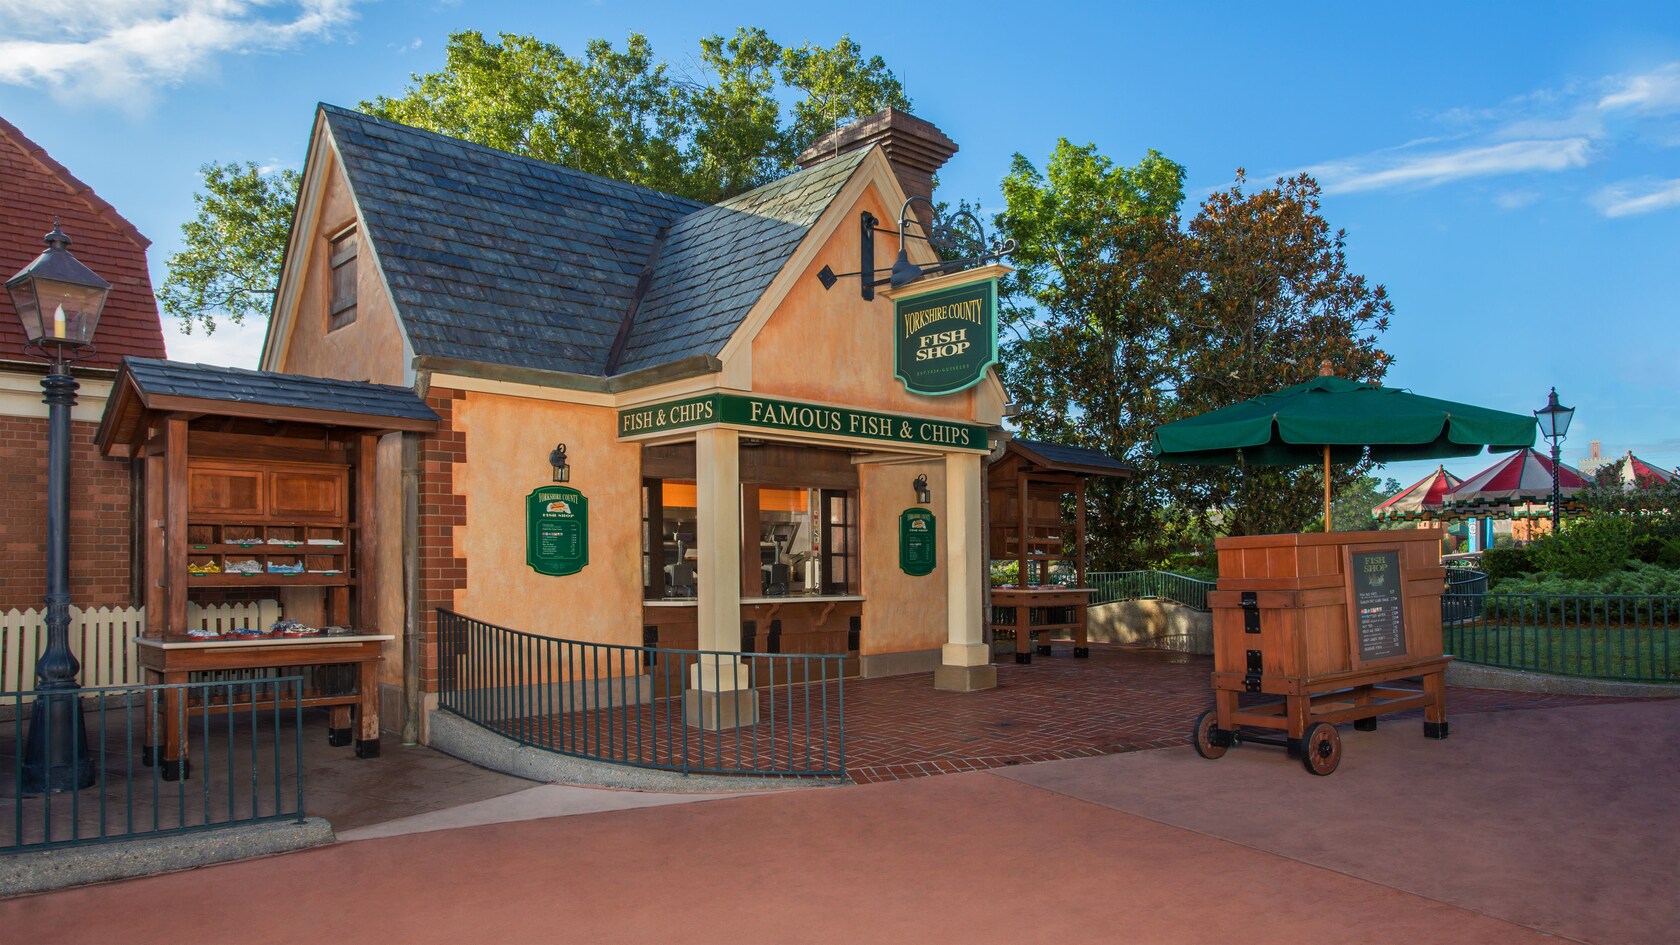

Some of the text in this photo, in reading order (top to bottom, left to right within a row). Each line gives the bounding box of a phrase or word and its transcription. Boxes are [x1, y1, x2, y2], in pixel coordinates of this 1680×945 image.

[904, 298, 982, 338] YORKSHIRE COUNTY
[919, 328, 967, 348] FISH
[916, 342, 970, 361] SHOP
[623, 400, 713, 432] FISH & CHIPS
[750, 401, 970, 445] FAMOUS FISH & CHIPS
[539, 493, 578, 504] YORKSHIRE COUNTY
[1363, 563, 1388, 573] SHOP
[1364, 557, 1386, 565] FISH
